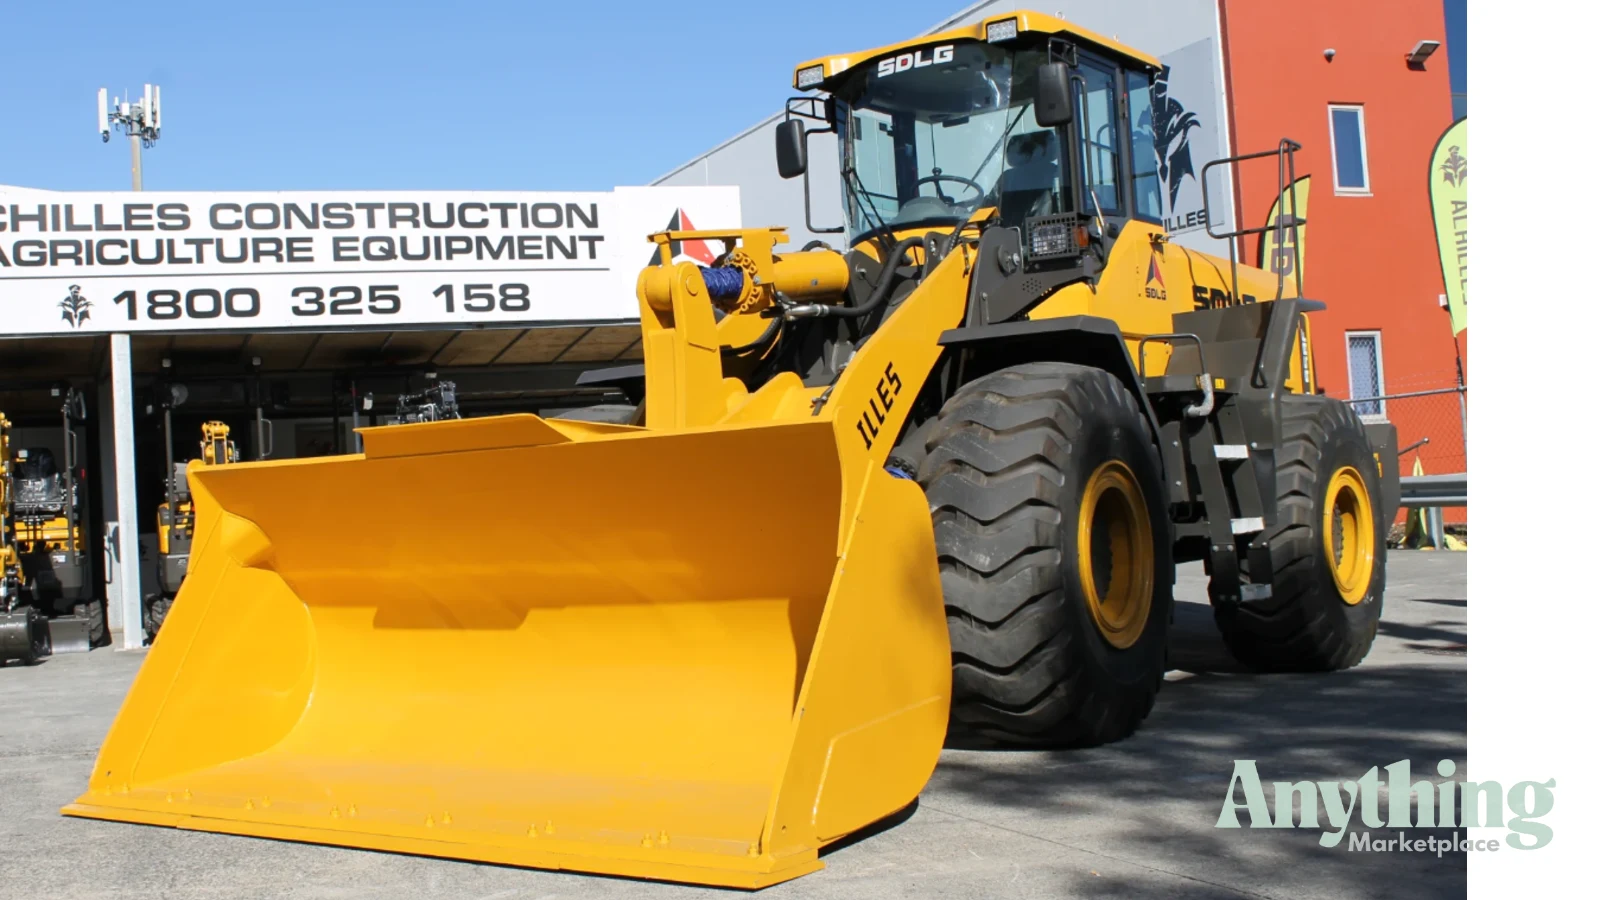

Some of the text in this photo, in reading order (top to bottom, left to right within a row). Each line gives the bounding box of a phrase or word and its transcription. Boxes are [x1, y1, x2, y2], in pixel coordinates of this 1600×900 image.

[877, 44, 954, 78] SDLG
[0, 202, 599, 232] HILLES CONSTRUCTION
[332, 235, 604, 262] EQUIPMENT
[113, 283, 531, 321] 1800 325 158
[1145, 287, 1167, 301] SDLG
[856, 361, 902, 451] ILLES
